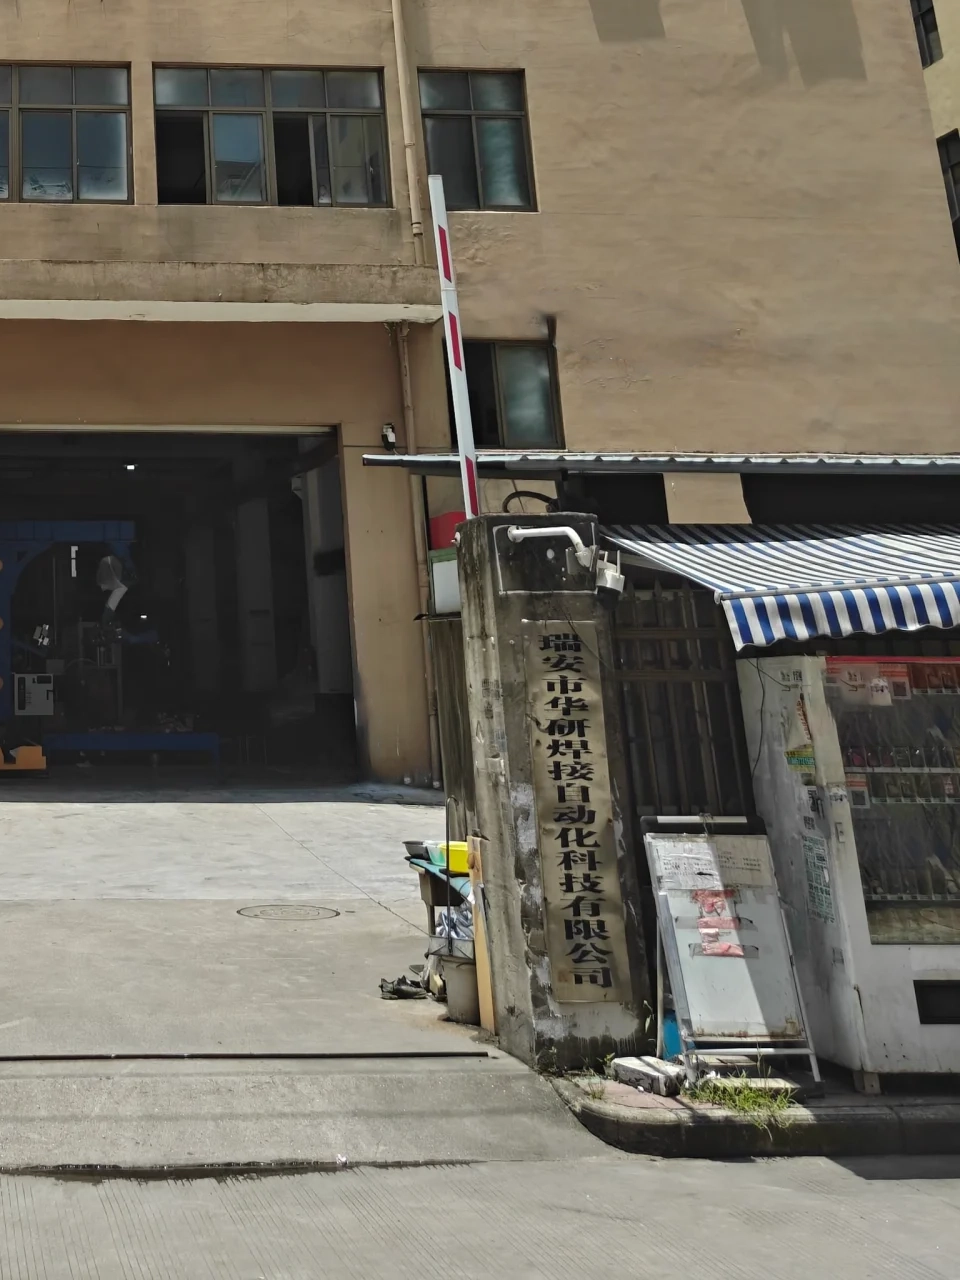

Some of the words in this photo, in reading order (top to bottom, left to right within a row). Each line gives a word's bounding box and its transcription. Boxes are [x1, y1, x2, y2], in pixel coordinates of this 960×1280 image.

[539, 632, 614, 988] 瑞安市华研焊接自动化科技有限公司
